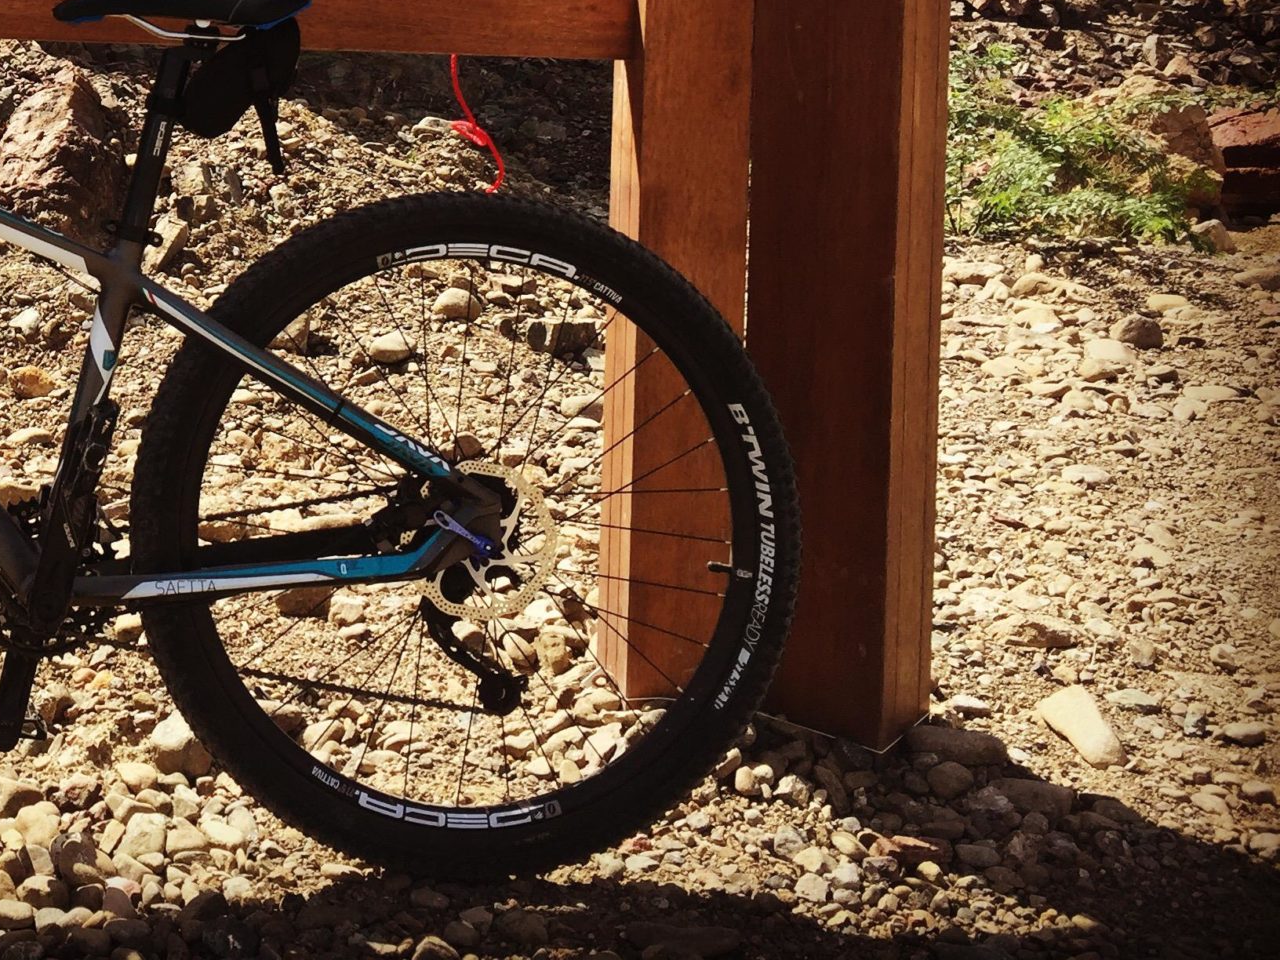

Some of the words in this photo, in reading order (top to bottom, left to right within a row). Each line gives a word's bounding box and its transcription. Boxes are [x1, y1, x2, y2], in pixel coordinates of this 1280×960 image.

[593, 281, 623, 305] CATTIVA
[373, 422, 451, 473] JAVA
[154, 577, 217, 595] SAETTA
[311, 765, 340, 790] CATTIVA
